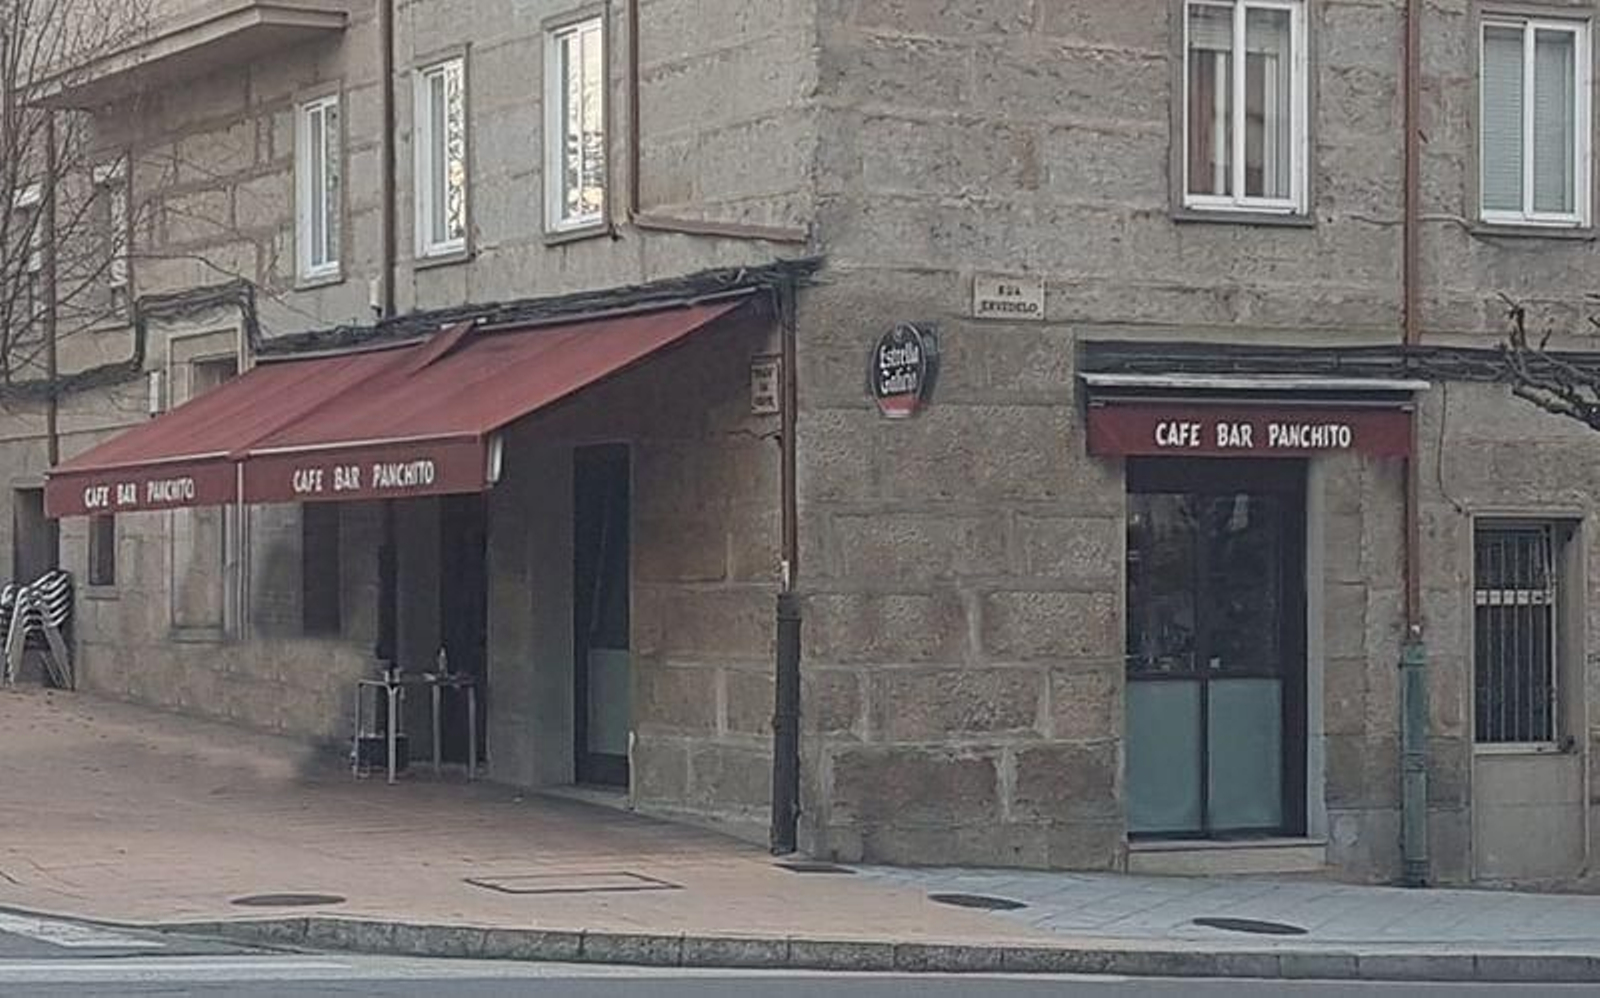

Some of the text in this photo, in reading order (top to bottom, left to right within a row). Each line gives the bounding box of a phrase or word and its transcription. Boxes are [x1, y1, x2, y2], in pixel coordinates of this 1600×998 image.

[880, 341, 919, 368] Estrella
[1155, 422, 1350, 447] CAFE BAR PANCHITO
[293, 461, 434, 492] CAFE BAR PANCHITO
[85, 478, 194, 508] CAFE BAR PANCHITO
